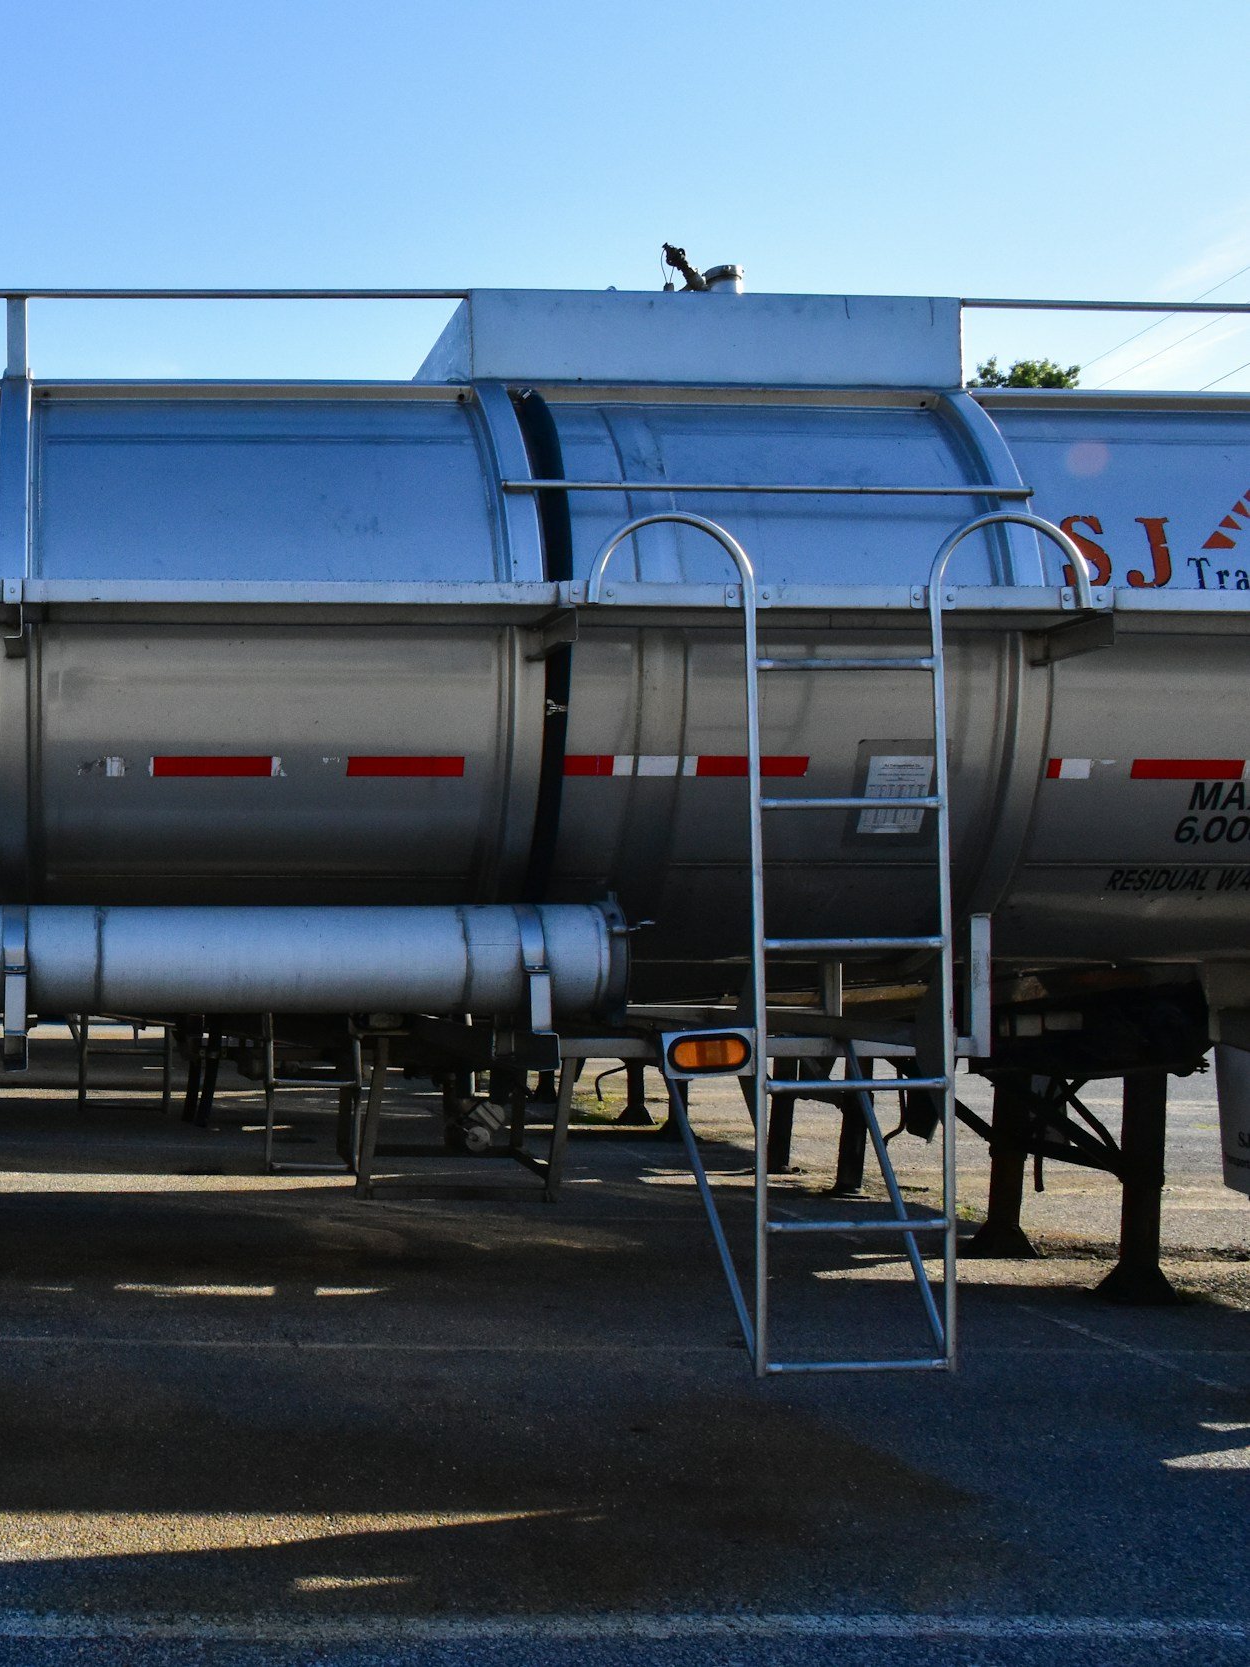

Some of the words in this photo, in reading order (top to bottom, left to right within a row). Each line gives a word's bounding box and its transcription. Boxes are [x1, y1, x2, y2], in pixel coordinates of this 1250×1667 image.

[1187, 557, 1250, 590] Tra
[1188, 782, 1250, 810] MA
[1174, 816, 1250, 844] 6,00
[1105, 869, 1209, 891] RESIDUAL
